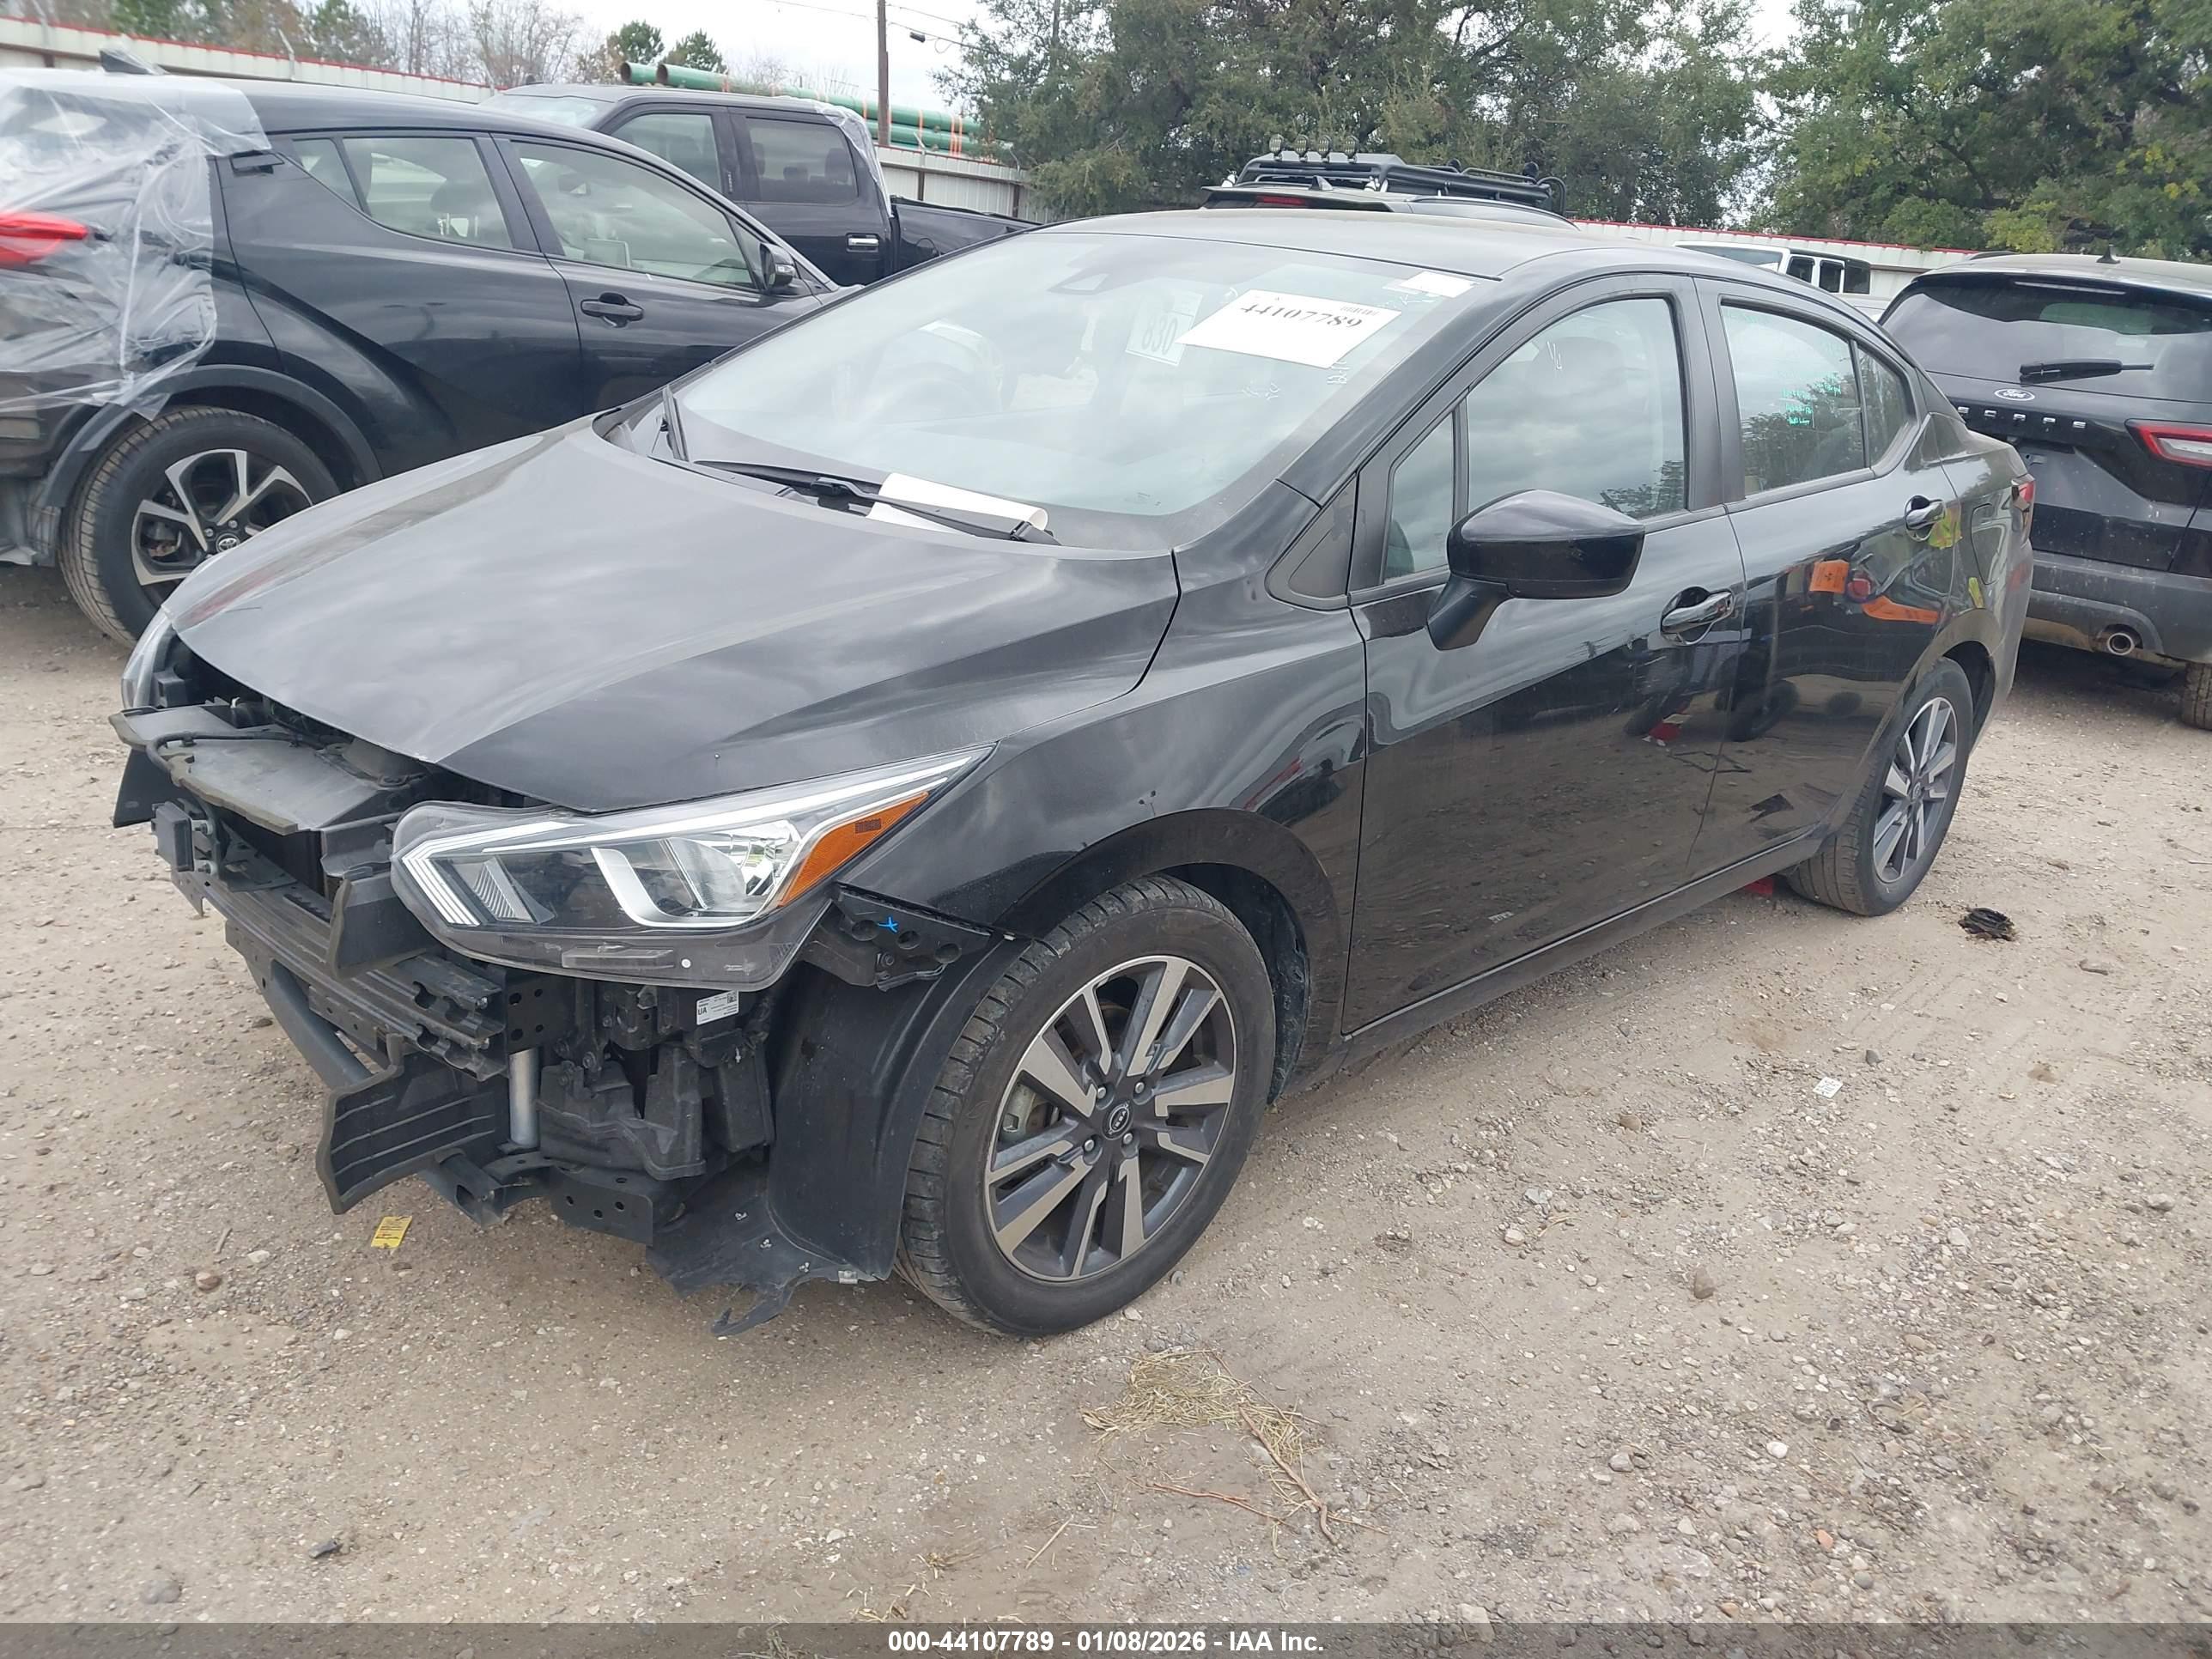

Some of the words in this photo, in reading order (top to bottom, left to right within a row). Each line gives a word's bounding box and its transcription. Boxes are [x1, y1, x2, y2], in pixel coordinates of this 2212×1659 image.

[1240, 303, 1363, 328] 44107789
[1140, 313, 1179, 356] 830
[2001, 389, 2031, 399] Ford
[1957, 405, 2087, 429] SCAPE
[697, 1006, 708, 1016] UA
